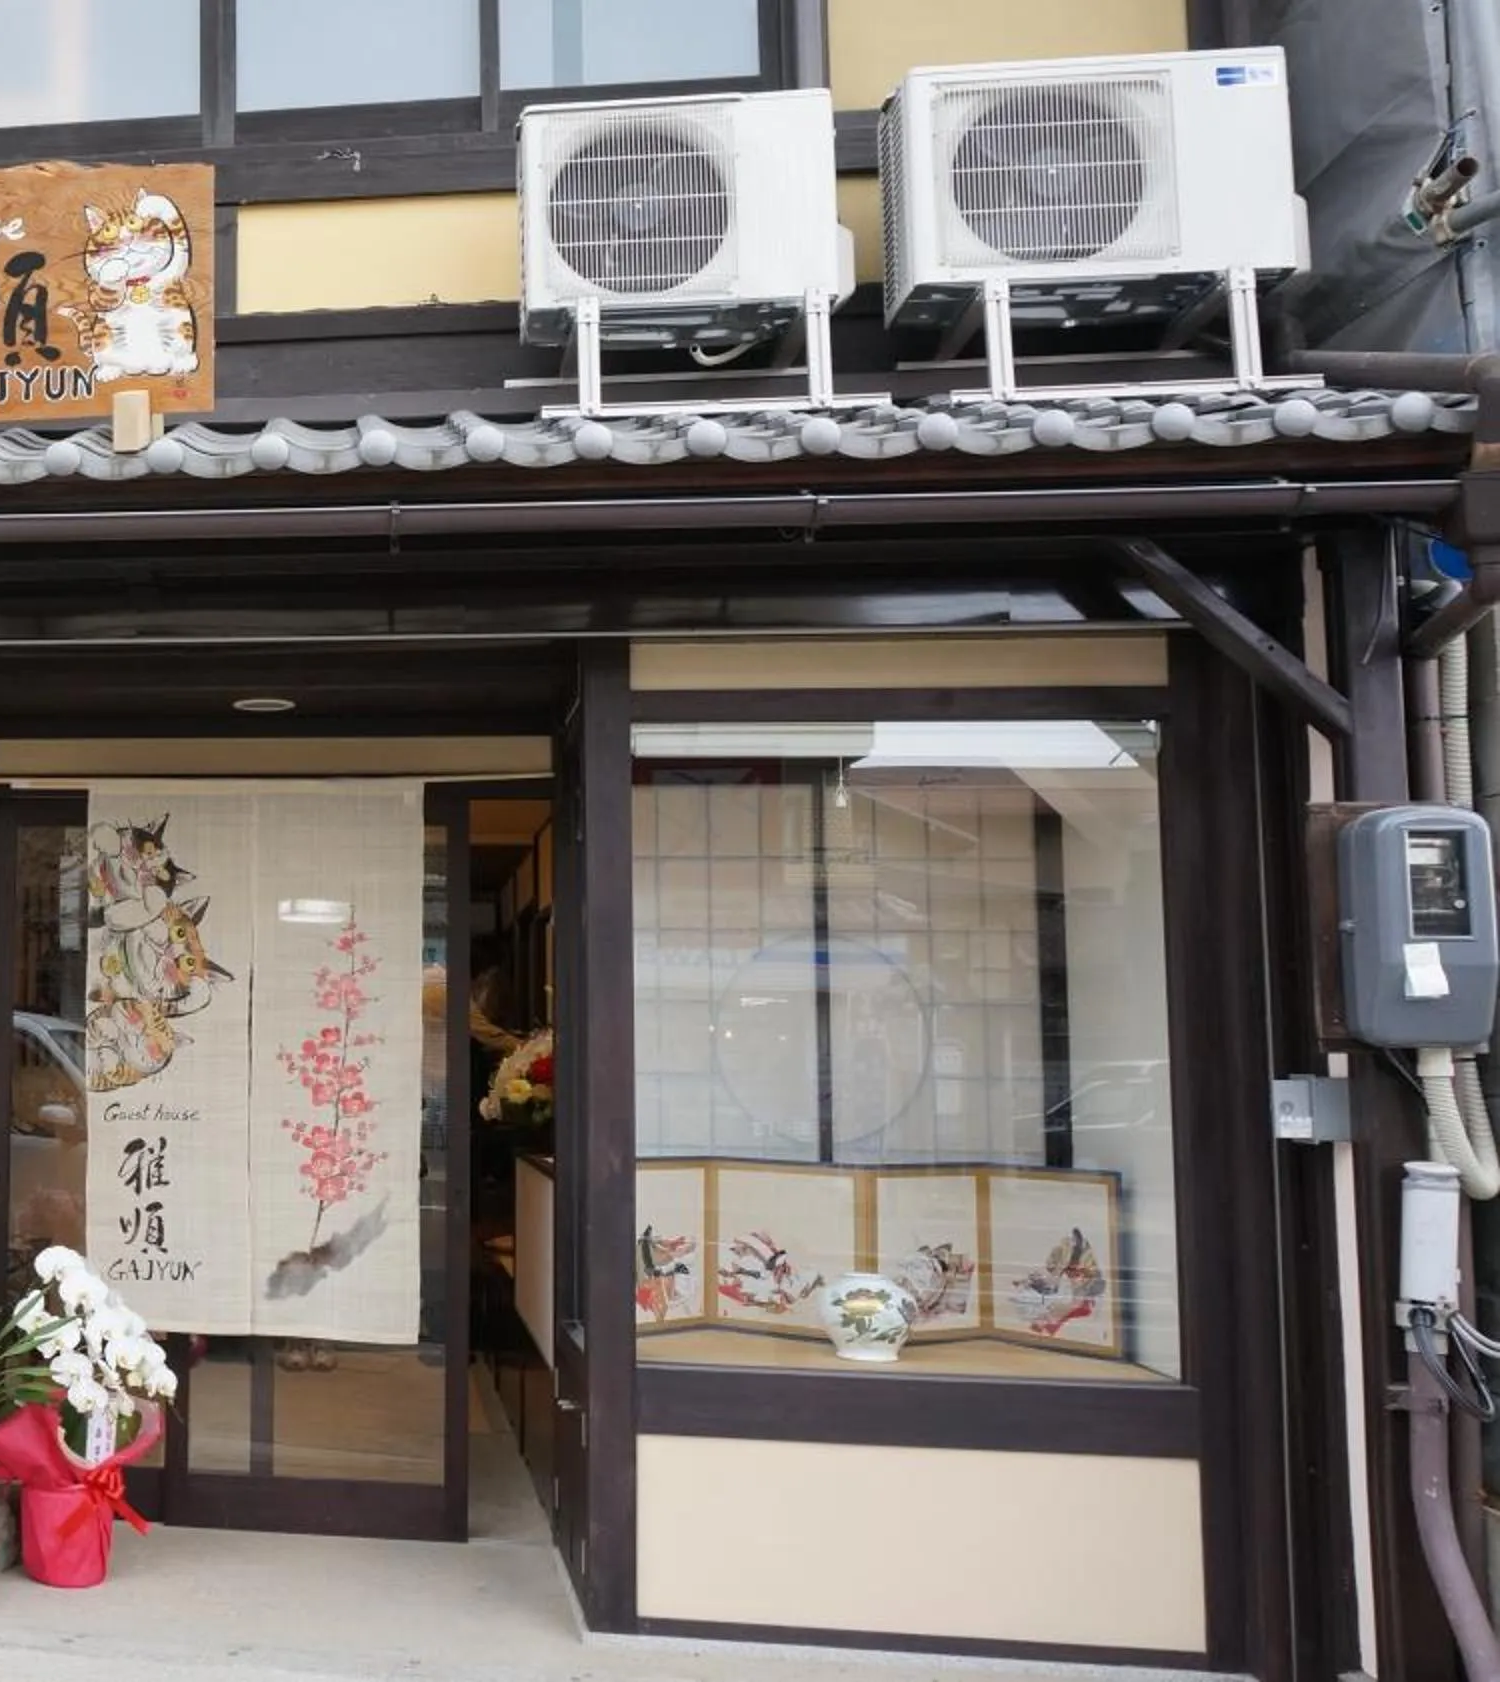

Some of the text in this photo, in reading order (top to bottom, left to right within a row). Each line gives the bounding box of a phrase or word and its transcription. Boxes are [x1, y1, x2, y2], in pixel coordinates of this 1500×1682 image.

[104, 1102, 200, 1121] Guest house
[107, 1258, 203, 1281] GAJYUN
